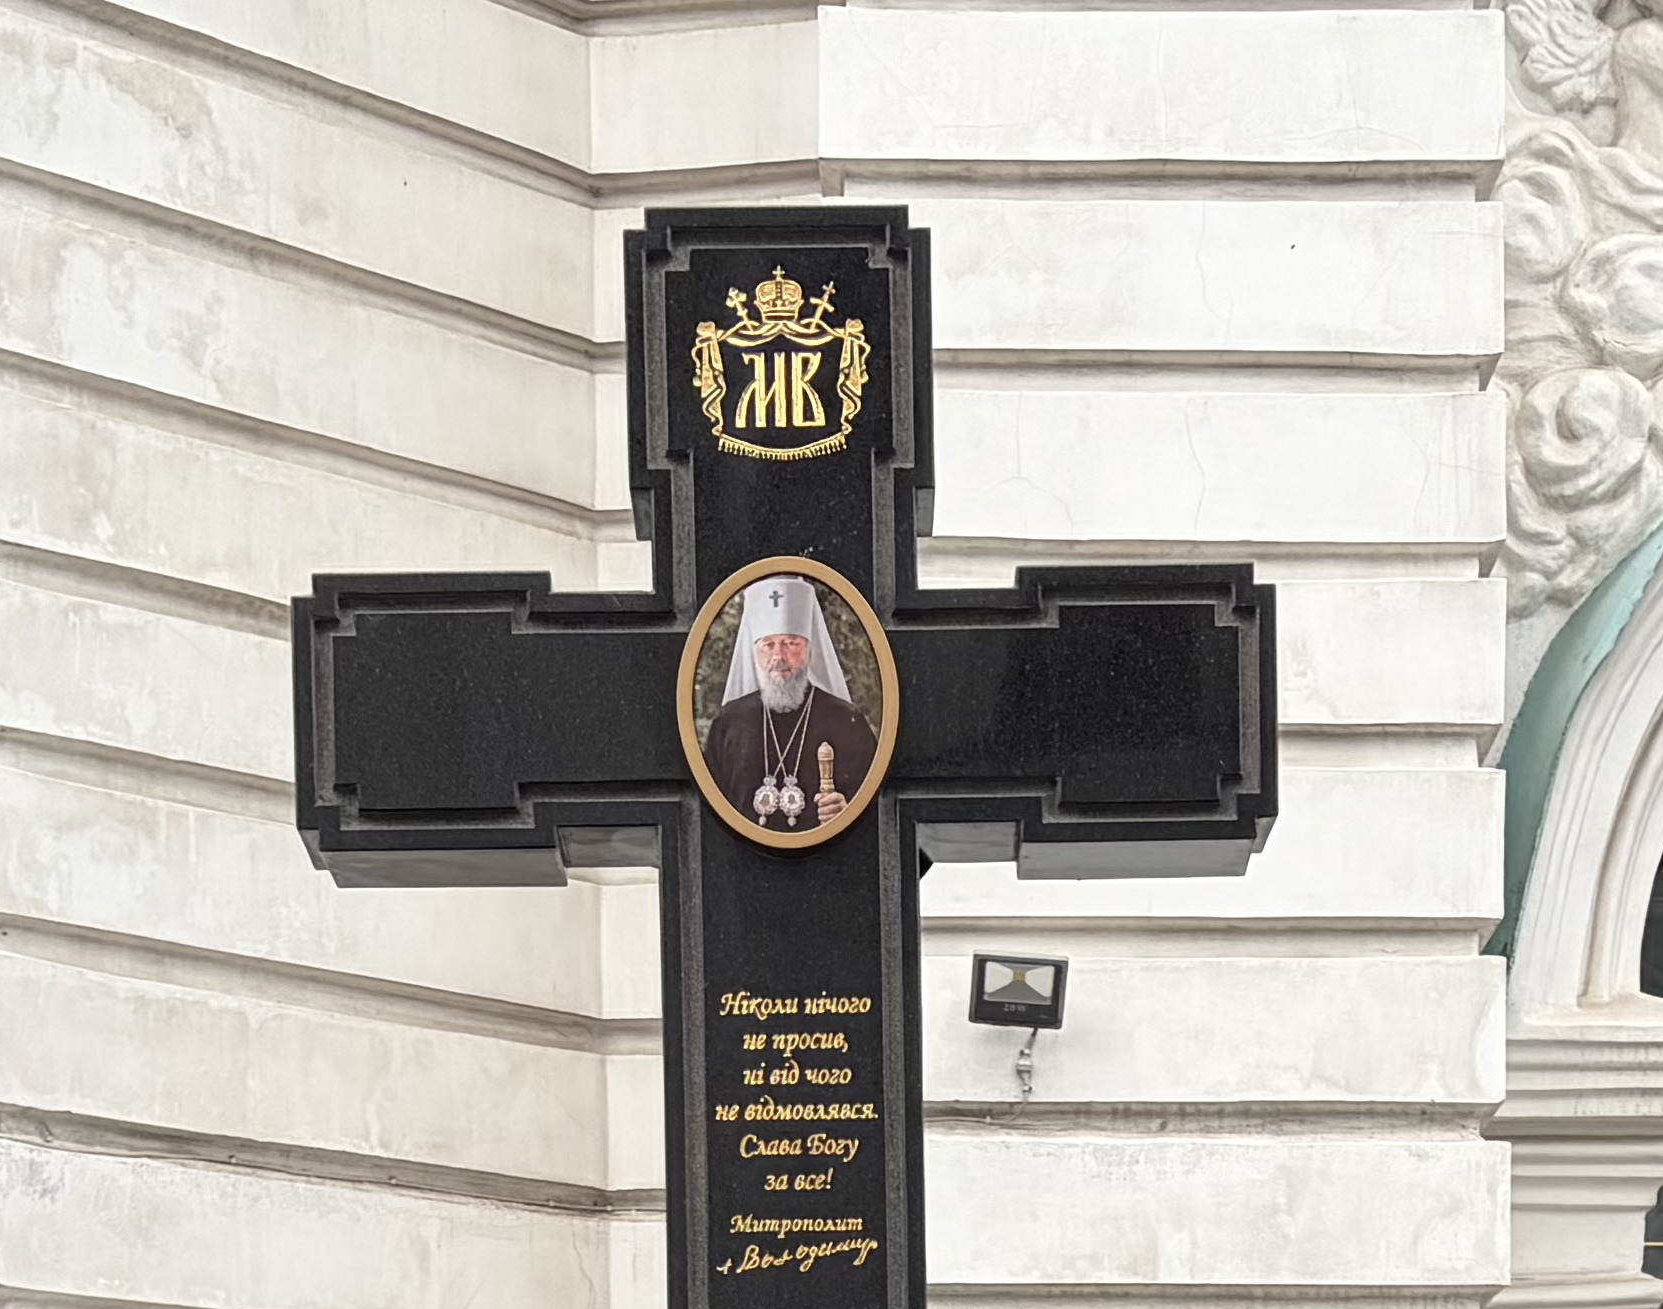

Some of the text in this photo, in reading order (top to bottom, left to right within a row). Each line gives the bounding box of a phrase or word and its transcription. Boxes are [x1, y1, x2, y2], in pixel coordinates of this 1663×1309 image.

[720, 991, 871, 1020] Ніколи нічого
[743, 1033, 848, 1057] не просив,
[743, 1059, 852, 1085] ні від чого
[716, 1095, 878, 1121] не відмовлявся.
[740, 1133, 859, 1162] Слава Богу
[764, 1168, 833, 1190] за все!
[730, 1214, 862, 1239] Митрополит
